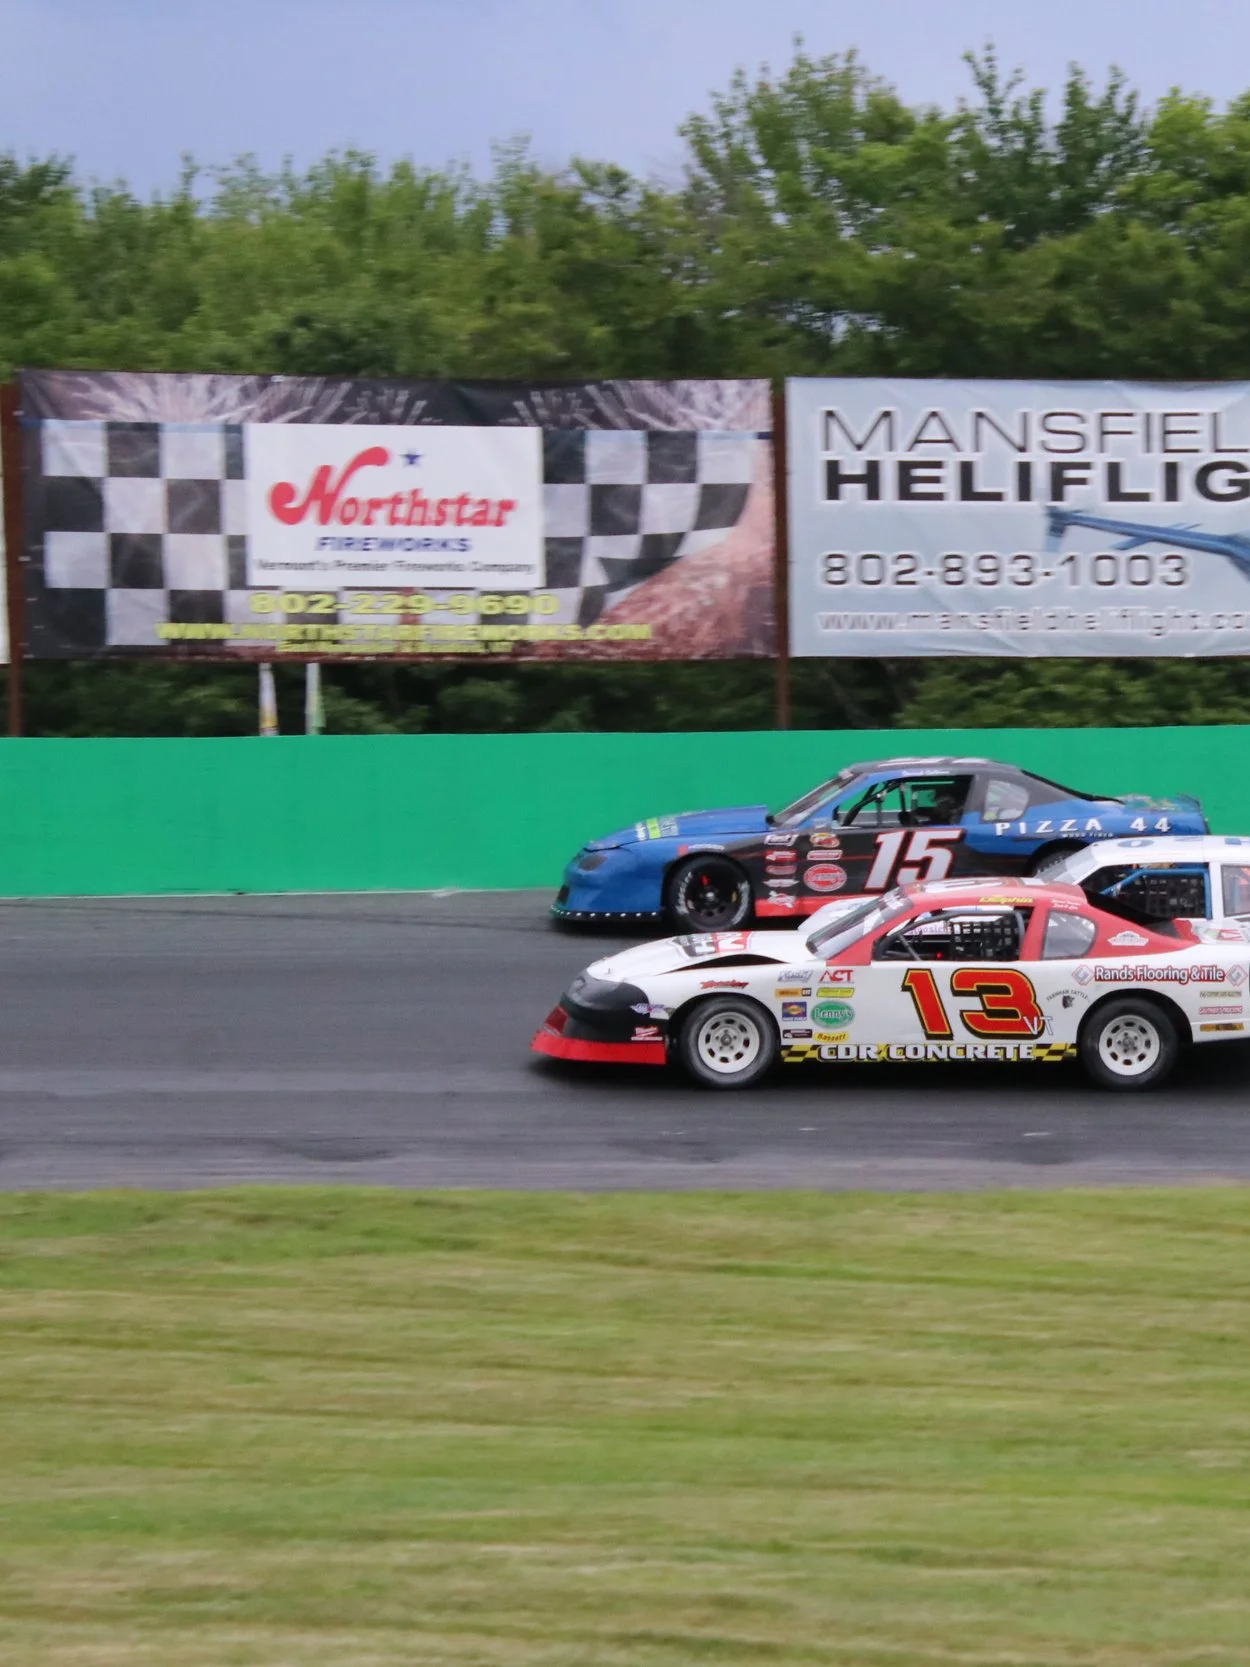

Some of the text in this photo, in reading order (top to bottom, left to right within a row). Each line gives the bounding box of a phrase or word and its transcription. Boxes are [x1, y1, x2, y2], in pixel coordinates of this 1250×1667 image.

[267, 446, 518, 527] Northstar
[315, 536, 474, 552] FIREWORKS
[249, 592, 559, 615] 802-229-9690
[995, 816, 1171, 836] PIZZA 44
[864, 829, 965, 890] 15
[819, 970, 854, 982] ACT
[1095, 966, 1134, 981] Rands
[1136, 965, 1188, 984] Flooring
[814, 1007, 853, 1020] Lenny's
[902, 968, 1045, 1041] 13
[1023, 1015, 1054, 1036] VT
[819, 1043, 1036, 1061] CDR CONCRETE
